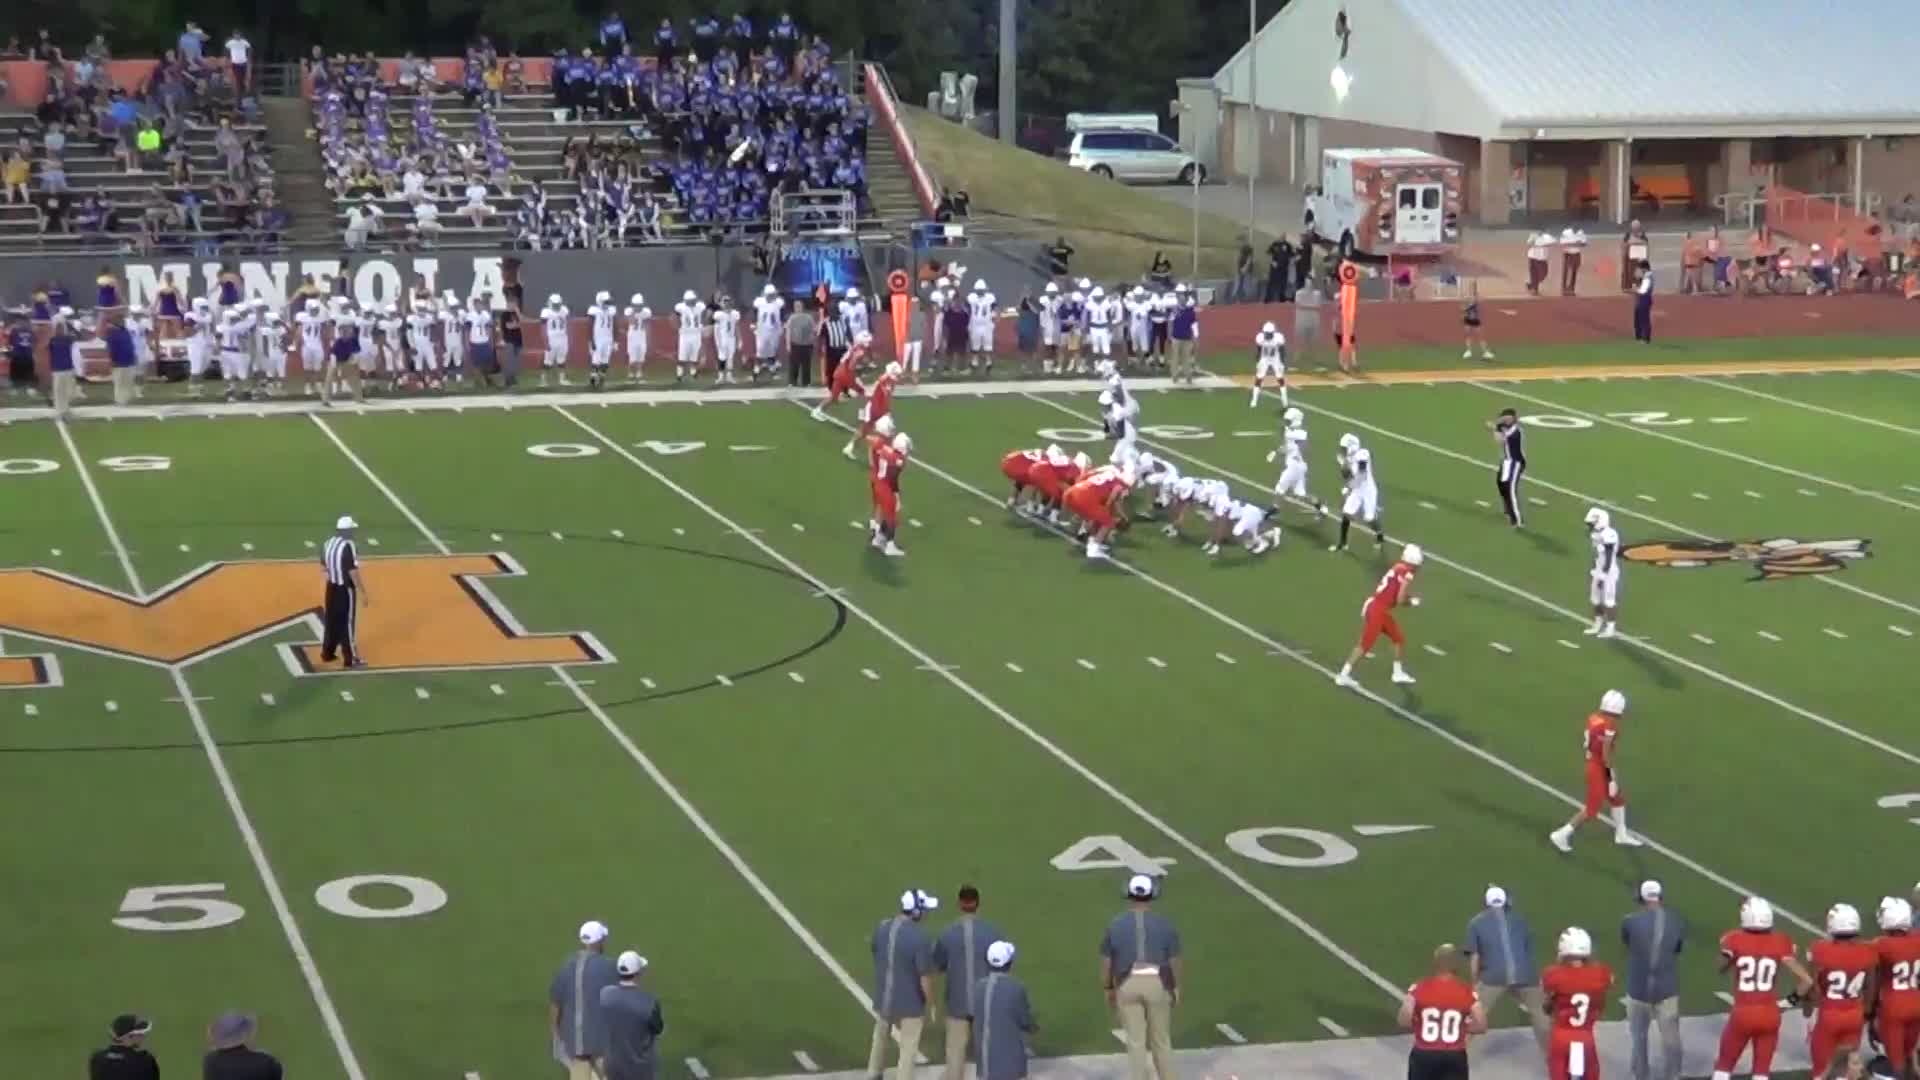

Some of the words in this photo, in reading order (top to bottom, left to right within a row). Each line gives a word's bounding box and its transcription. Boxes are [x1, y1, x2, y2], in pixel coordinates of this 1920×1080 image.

[1737, 955, 1777, 992] 20
[1827, 970, 1867, 1000] 24
[1421, 1007, 1462, 1044] 60
[1568, 992, 1591, 1028] 3
